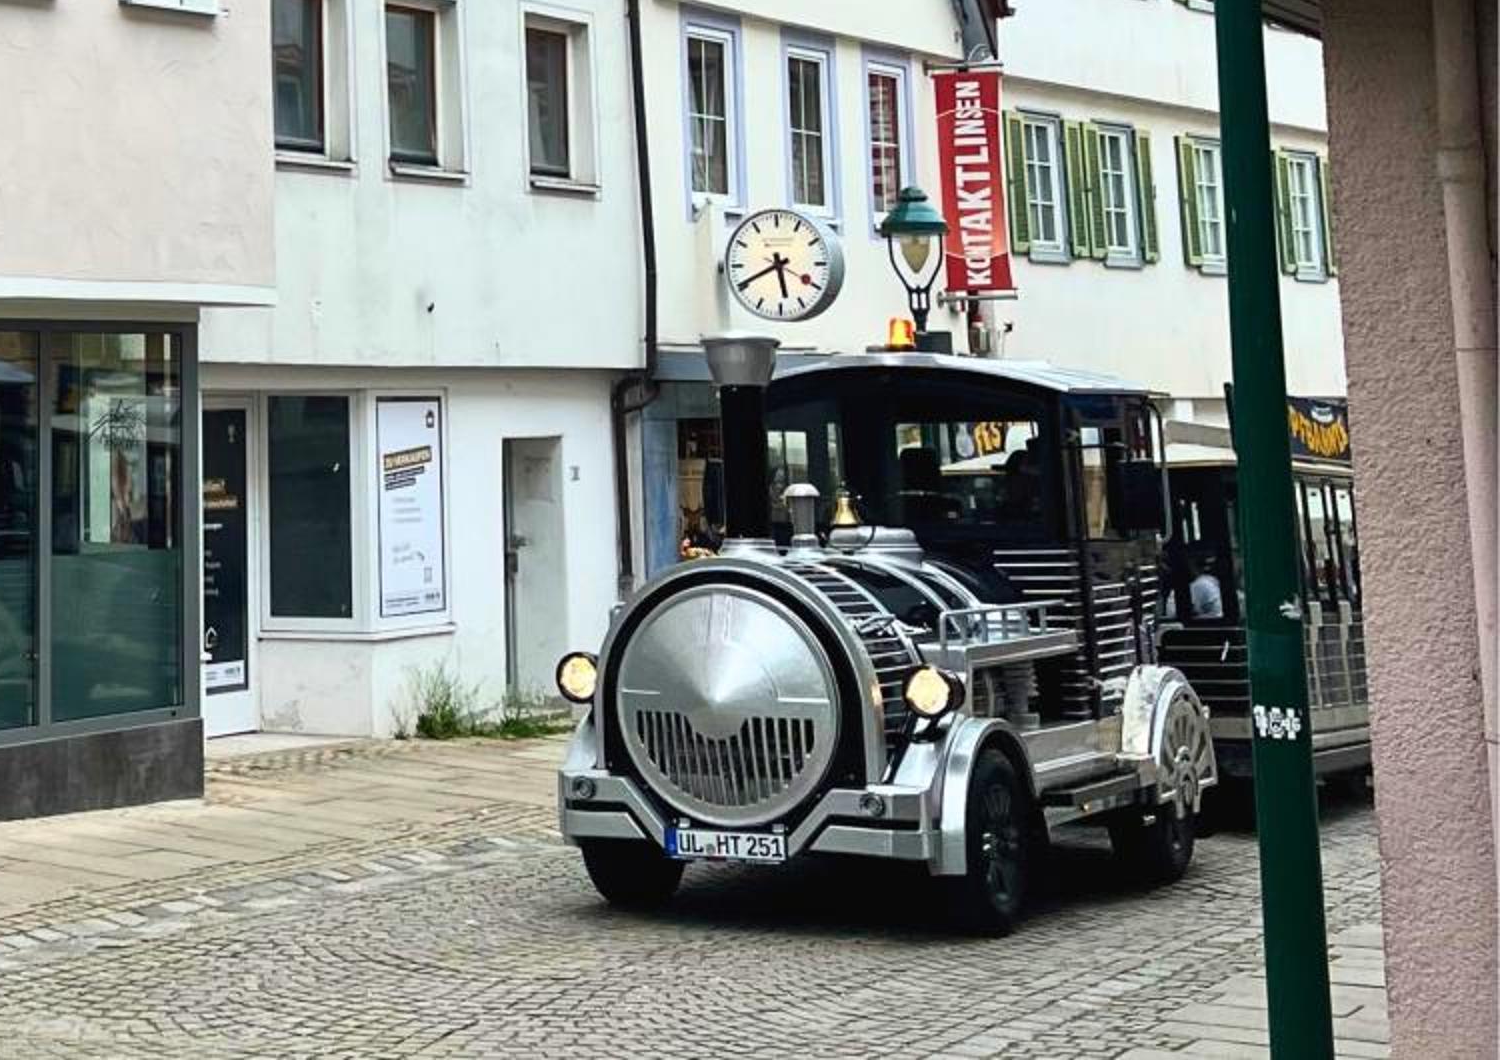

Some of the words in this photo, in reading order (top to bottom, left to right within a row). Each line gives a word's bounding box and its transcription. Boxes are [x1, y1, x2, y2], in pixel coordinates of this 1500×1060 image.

[679, 833, 704, 853] UL
[716, 835, 741, 855] HT
[746, 836, 783, 858] 251
